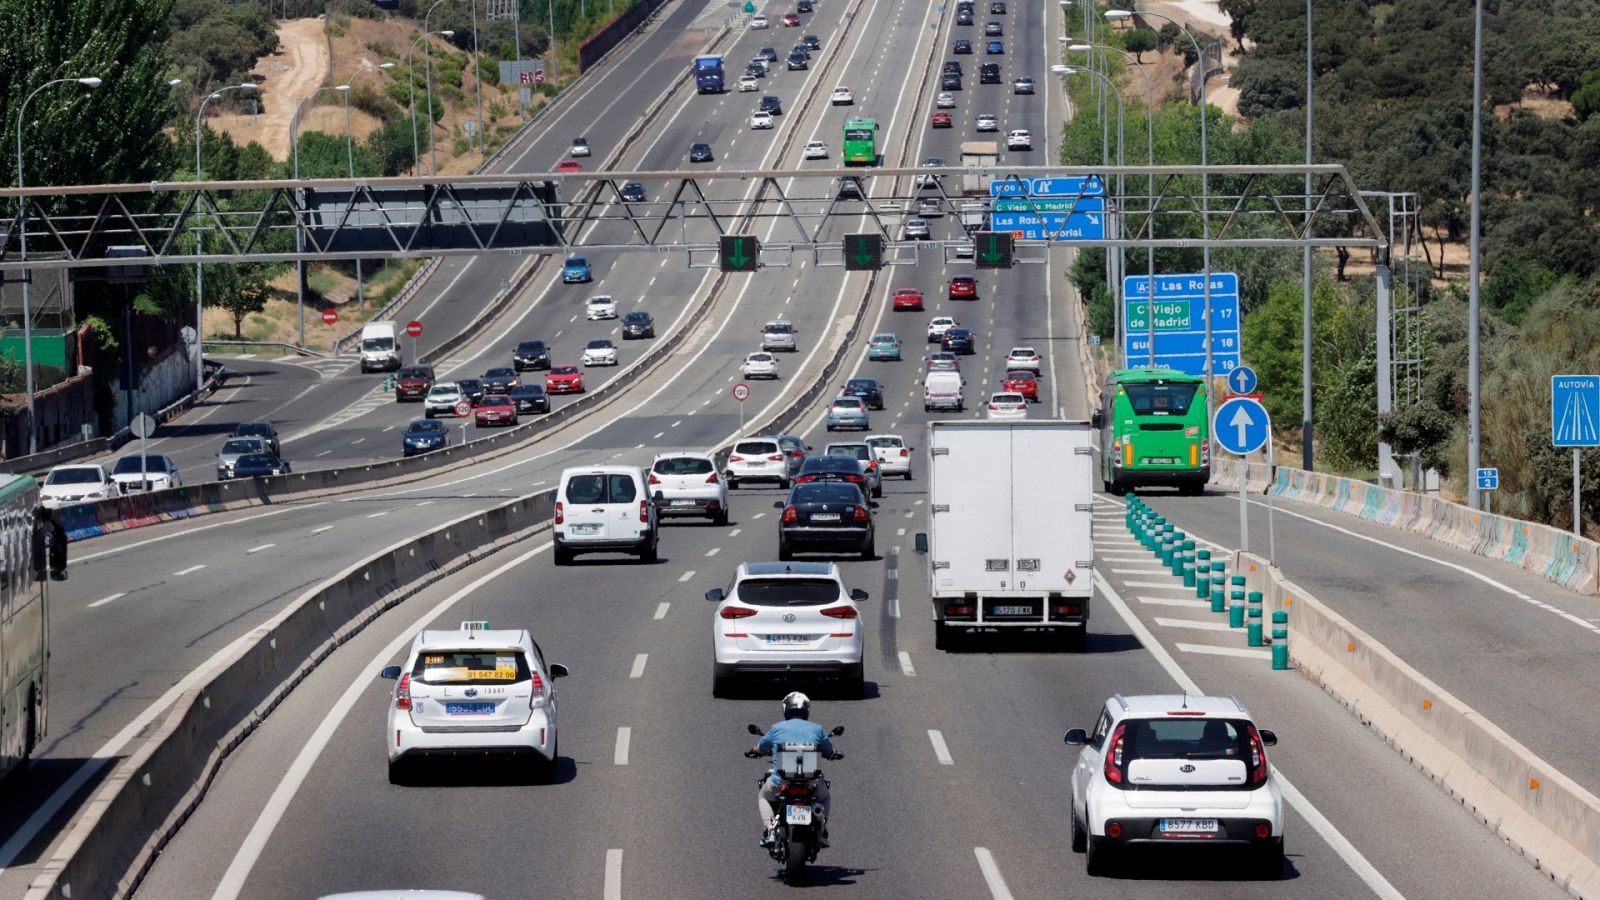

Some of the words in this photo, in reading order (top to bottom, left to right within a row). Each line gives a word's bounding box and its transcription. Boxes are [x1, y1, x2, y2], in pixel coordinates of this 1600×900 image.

[1007, 203, 1027, 211] Viejo
[1045, 202, 1073, 210] Madrid
[996, 217, 1013, 226] Las
[1026, 230, 1037, 238] El
[1162, 281, 1182, 291] Las
[1189, 280, 1224, 290] Roas
[1153, 304, 1182, 315] Viejo
[1220, 308, 1232, 318] 17
[1130, 319, 1144, 328] de
[1220, 338, 1234, 347] 18
[1222, 360, 1234, 370] 19
[1558, 379, 1595, 389] AUTOVÍA
[1484, 478, 1491, 487] 2
[1167, 820, 1192, 829] 8577
[1196, 820, 1214, 829] KBD
